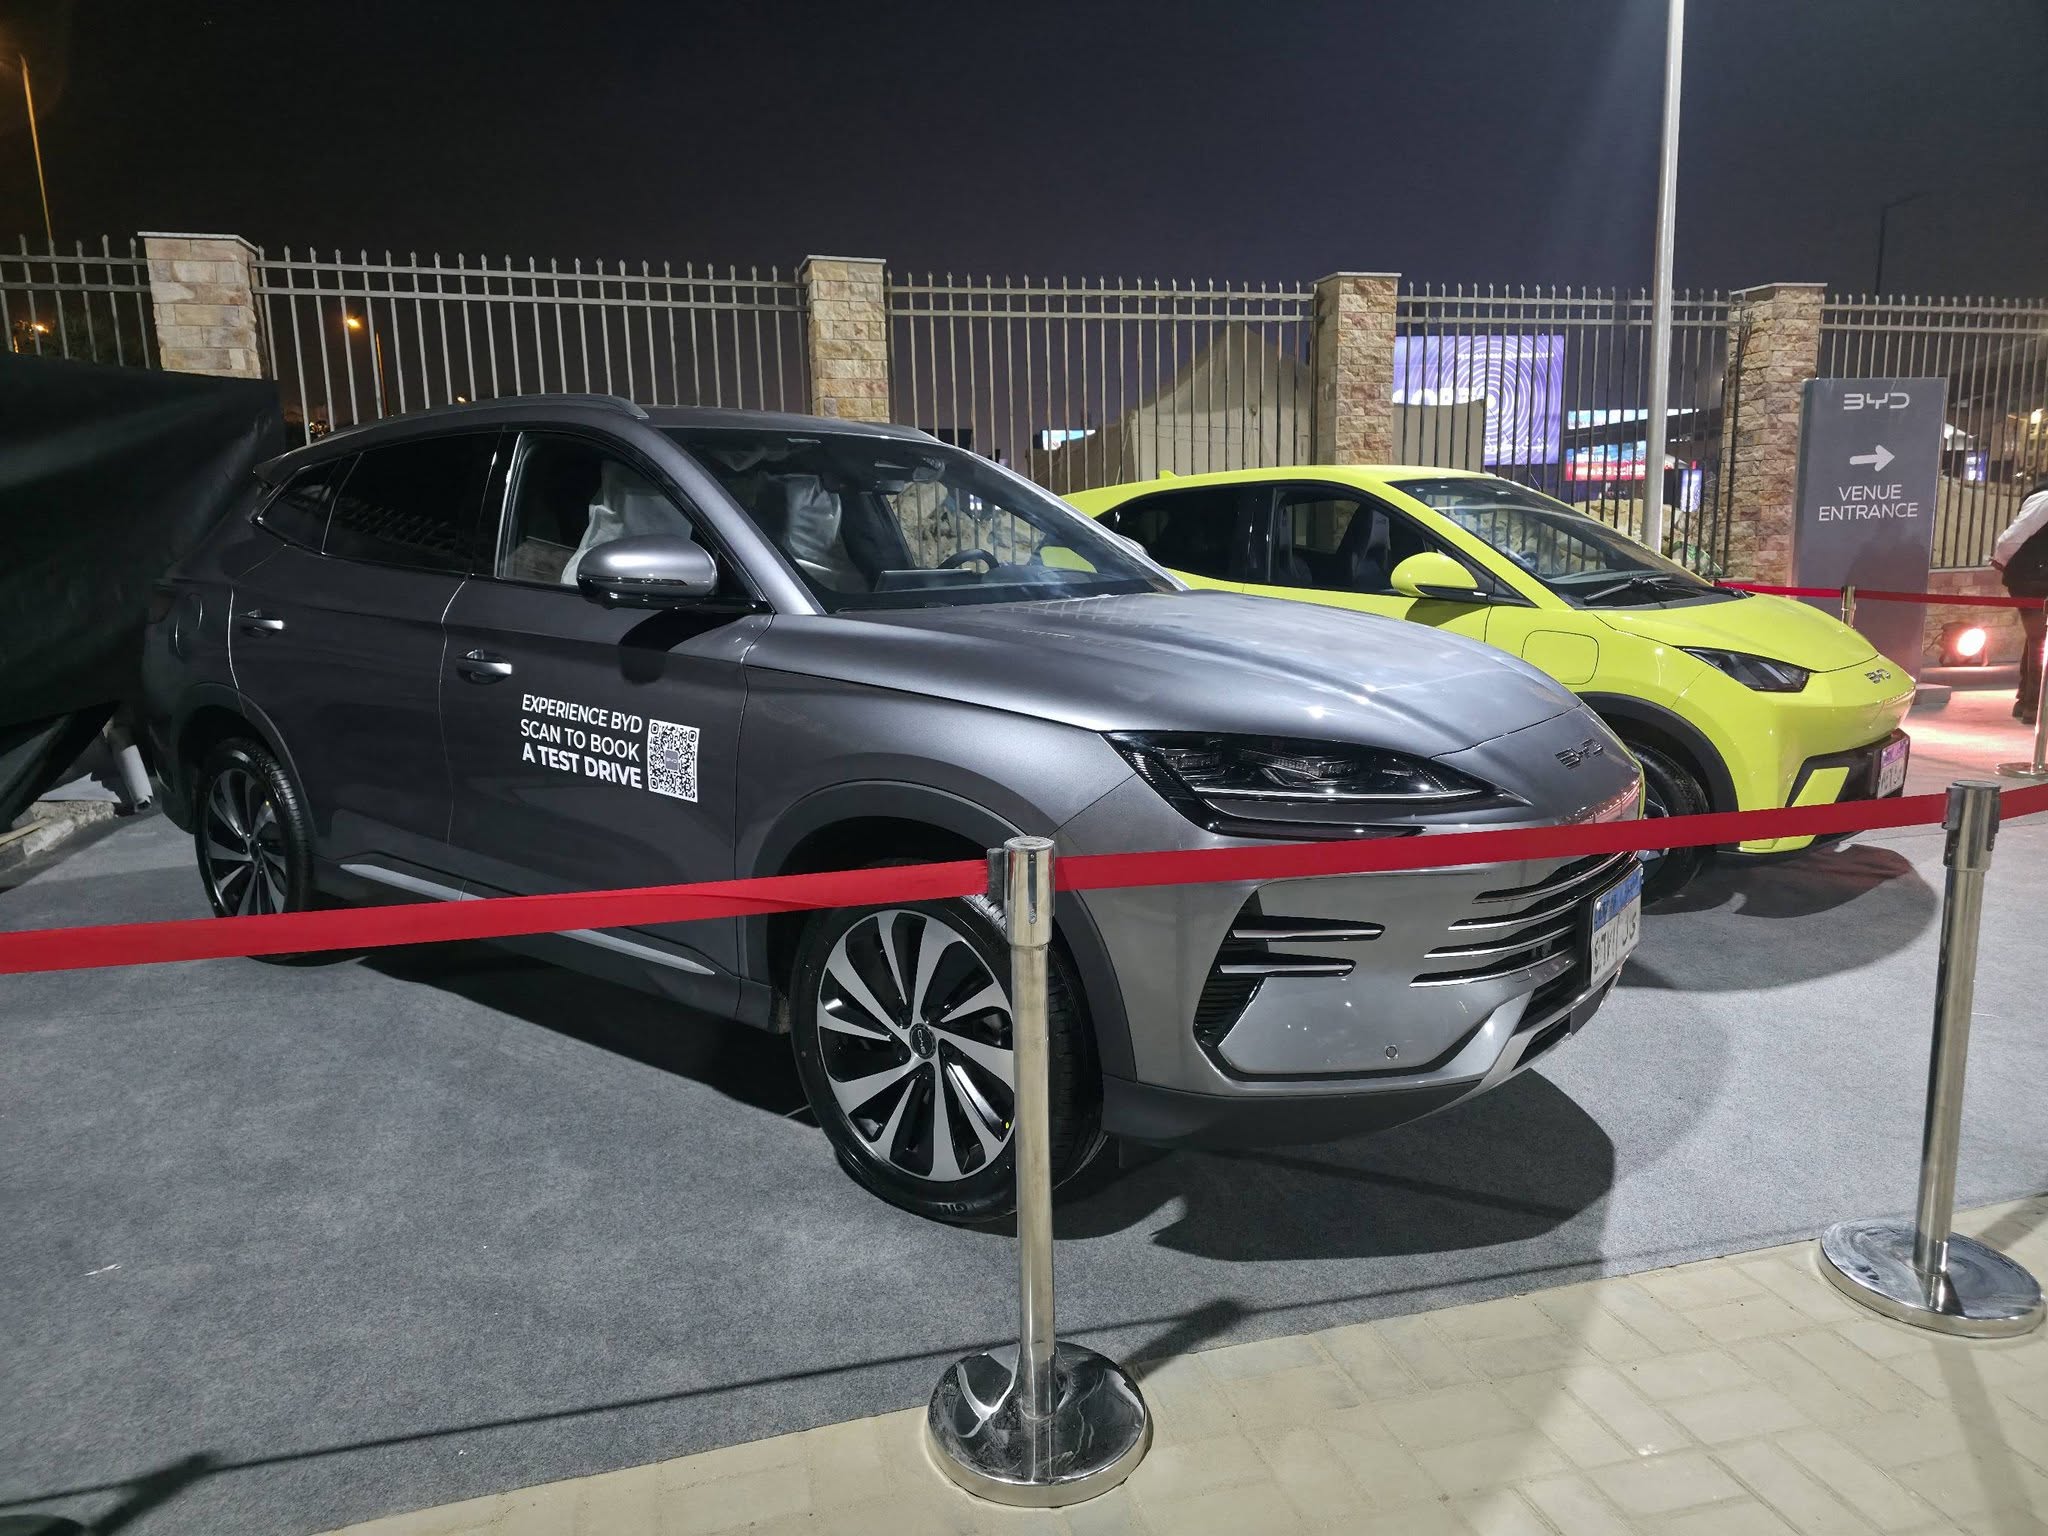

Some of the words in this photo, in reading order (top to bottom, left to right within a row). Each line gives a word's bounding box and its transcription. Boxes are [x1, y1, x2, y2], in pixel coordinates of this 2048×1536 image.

[1844, 392, 1910, 410] BYD
[1839, 484, 1902, 501] VENUE
[1819, 503, 1918, 521] ENTRANCE
[522, 694, 608, 727] EXPERIENCE
[611, 712, 642, 733] BYD
[521, 719, 561, 743] SCAN
[565, 728, 585, 748] TO
[590, 734, 640, 762] BOOK
[1555, 739, 1603, 769] BYD
[522, 743, 535, 763] A
[537, 745, 579, 773] TEST
[584, 756, 642, 788] DRIVE
